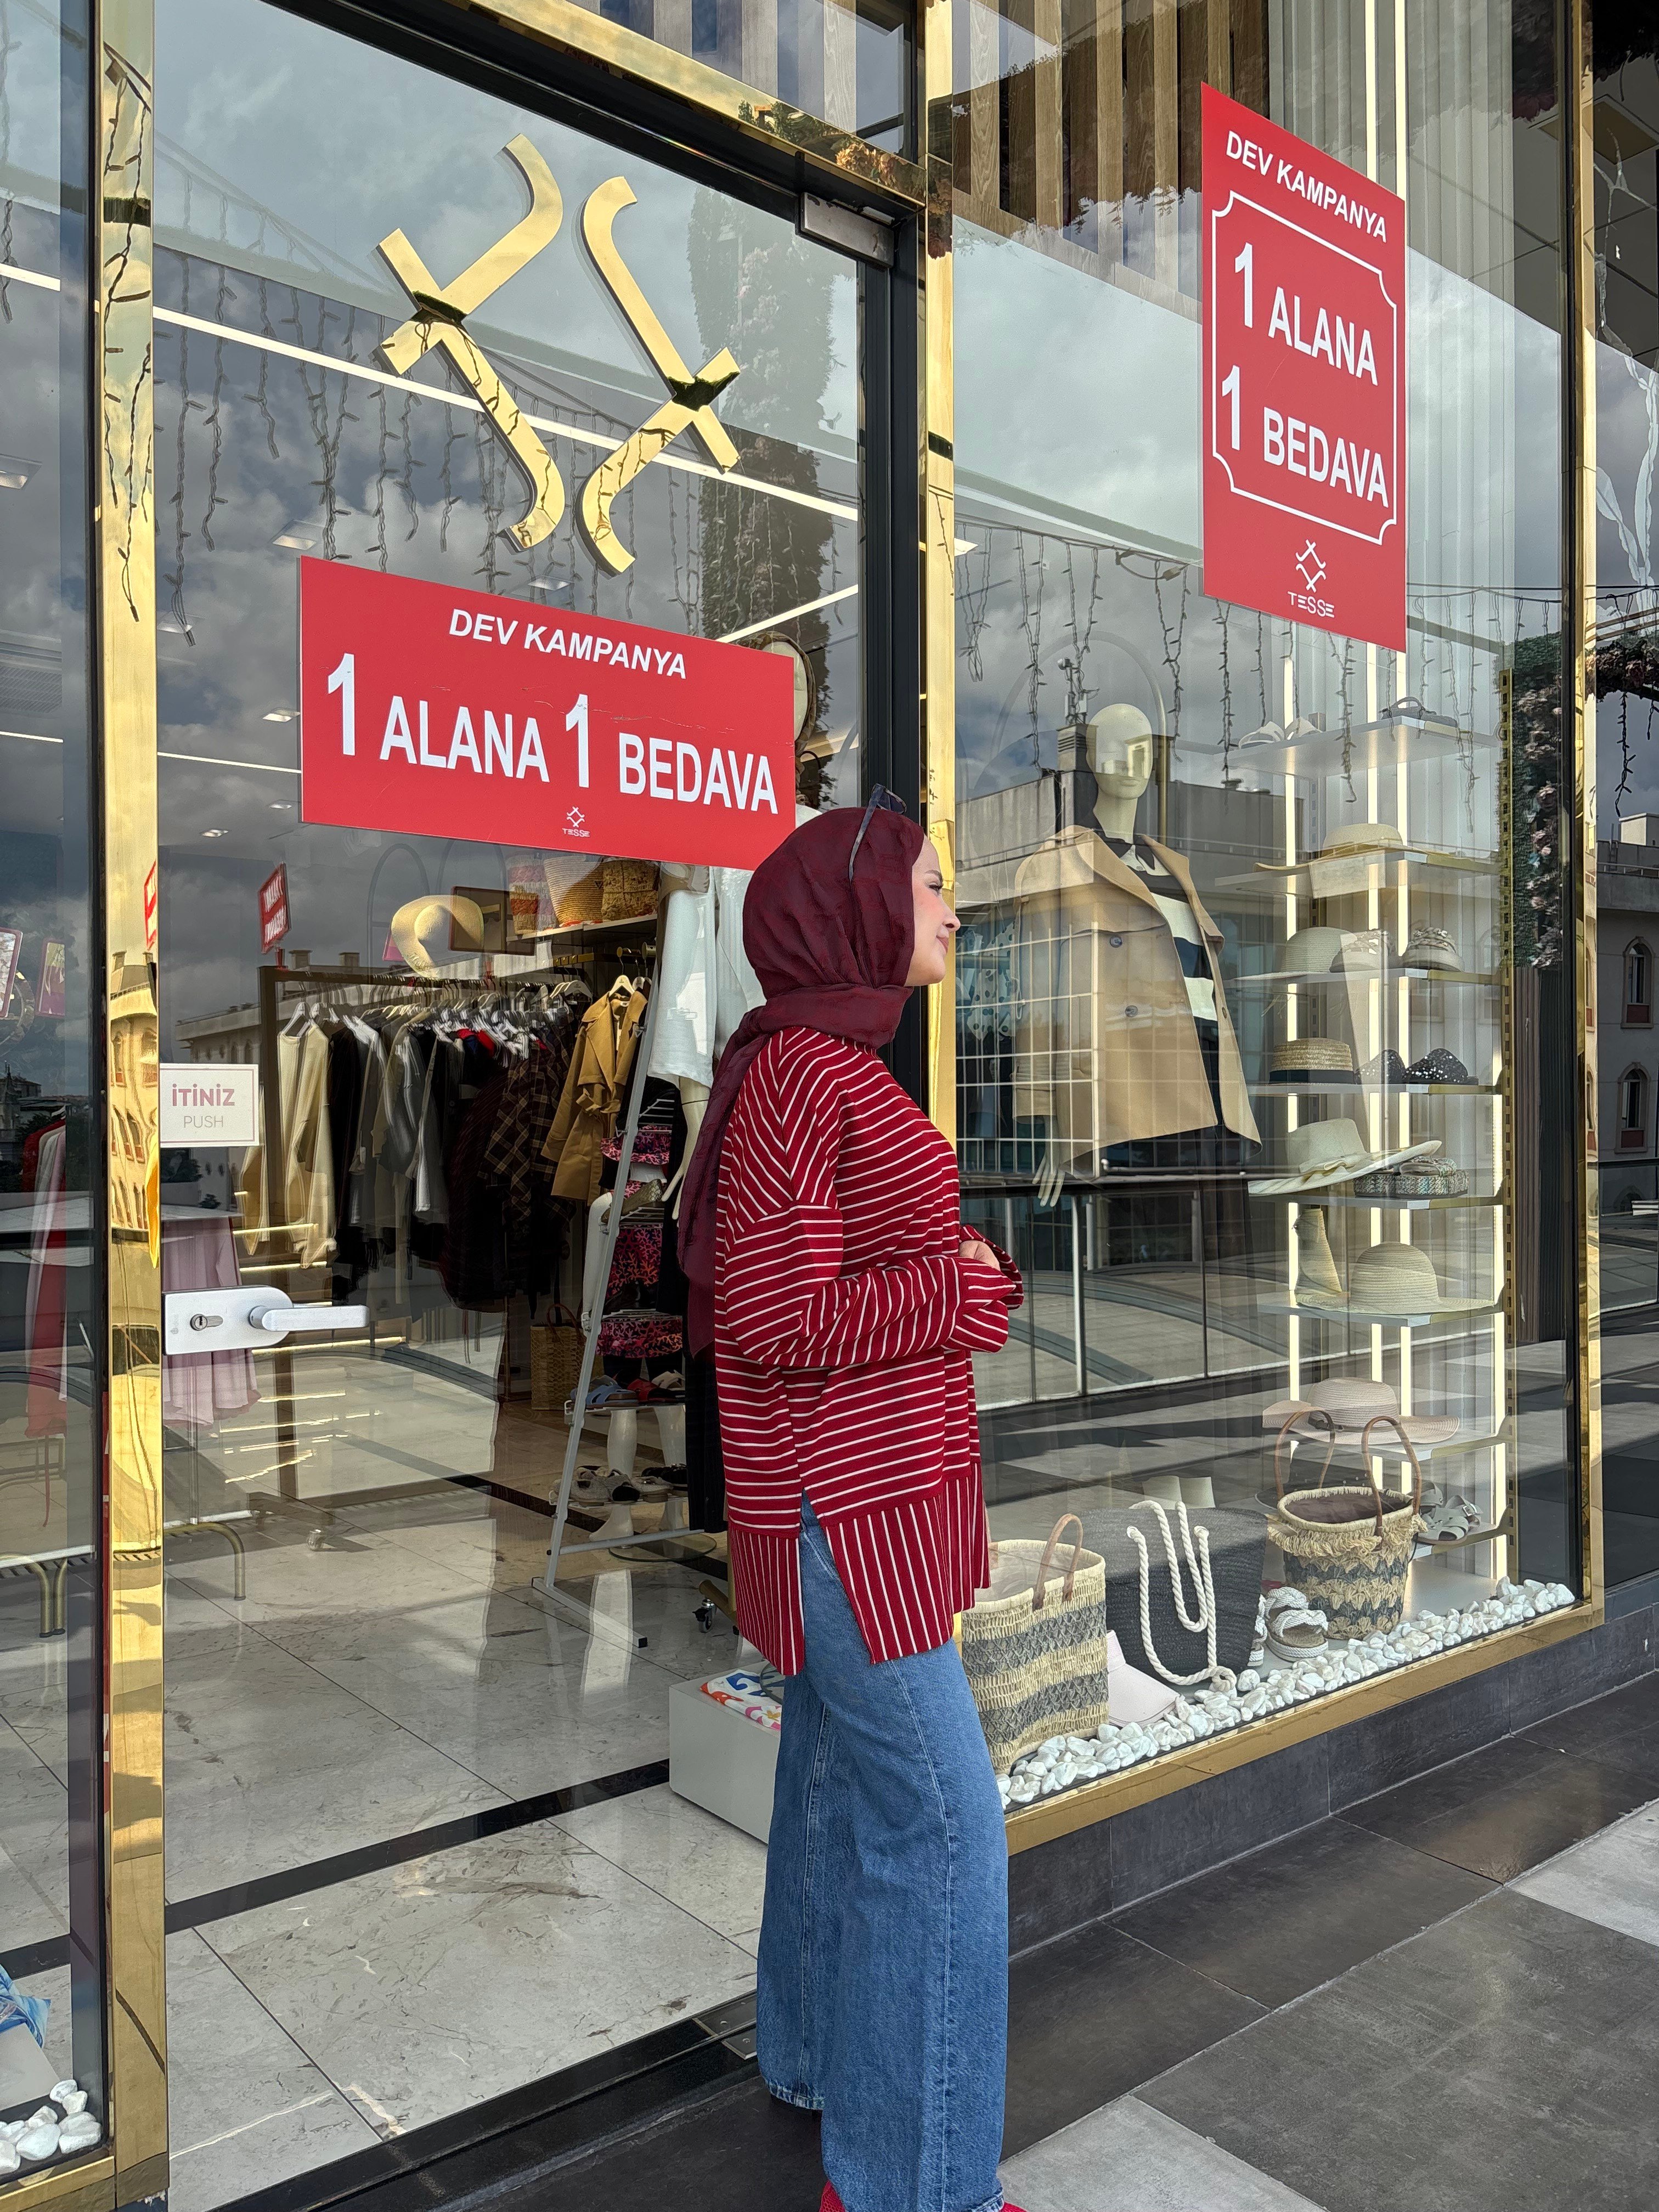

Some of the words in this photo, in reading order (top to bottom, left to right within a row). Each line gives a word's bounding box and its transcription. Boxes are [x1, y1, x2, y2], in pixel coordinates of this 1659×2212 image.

[1226, 131, 1273, 176] DEV
[1277, 159, 1386, 243] KAMPANYA
[1235, 242, 1252, 329] 1
[1268, 286, 1378, 386] ALANA
[1222, 365, 1240, 451] 1
[1263, 407, 1389, 508] BEDAVA
[1287, 591, 1335, 618] TESSE
[449, 608, 518, 645] DEV
[524, 623, 686, 679] KAMPANYA
[328, 653, 356, 756] 1
[379, 695, 550, 783] ALANA
[566, 693, 589, 788] 1
[619, 732, 778, 815] BEDAVA
[562, 828, 590, 838] TESSE
[172, 1083, 235, 1107] İTİNİZ
[183, 1115, 224, 1128] PUSH
